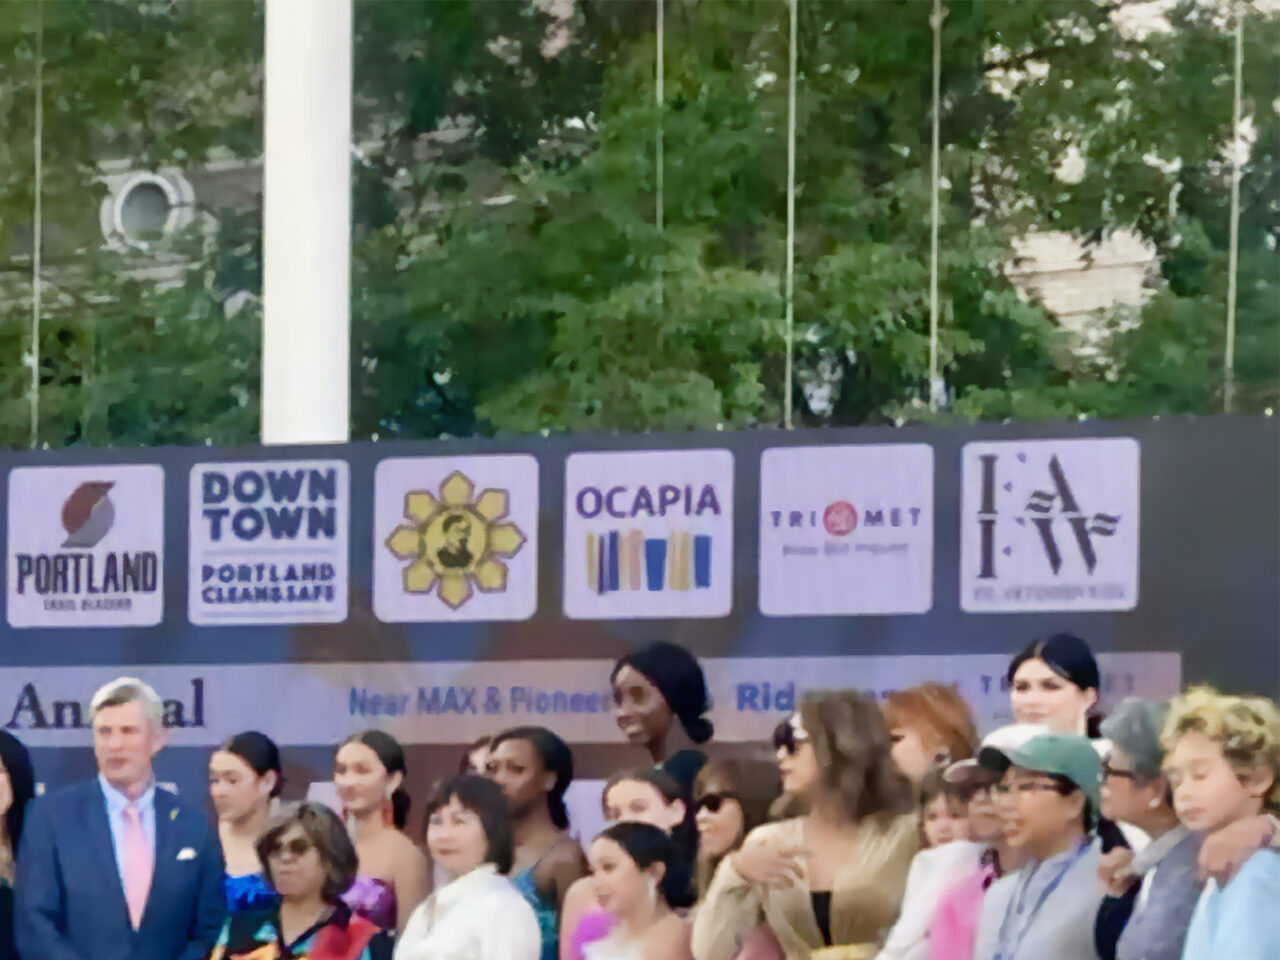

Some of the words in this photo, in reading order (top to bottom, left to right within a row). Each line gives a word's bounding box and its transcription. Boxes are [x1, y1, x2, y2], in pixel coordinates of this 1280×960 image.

[202, 468, 337, 504] DOWN
[576, 484, 721, 519] OCAPIA
[202, 506, 337, 542] TOWN
[16, 552, 158, 594] PORTLAND
[202, 563, 336, 583] PORTLAND
[6, 677, 207, 729] Anal
[348, 686, 411, 717] Near
[417, 686, 478, 716] MAX
